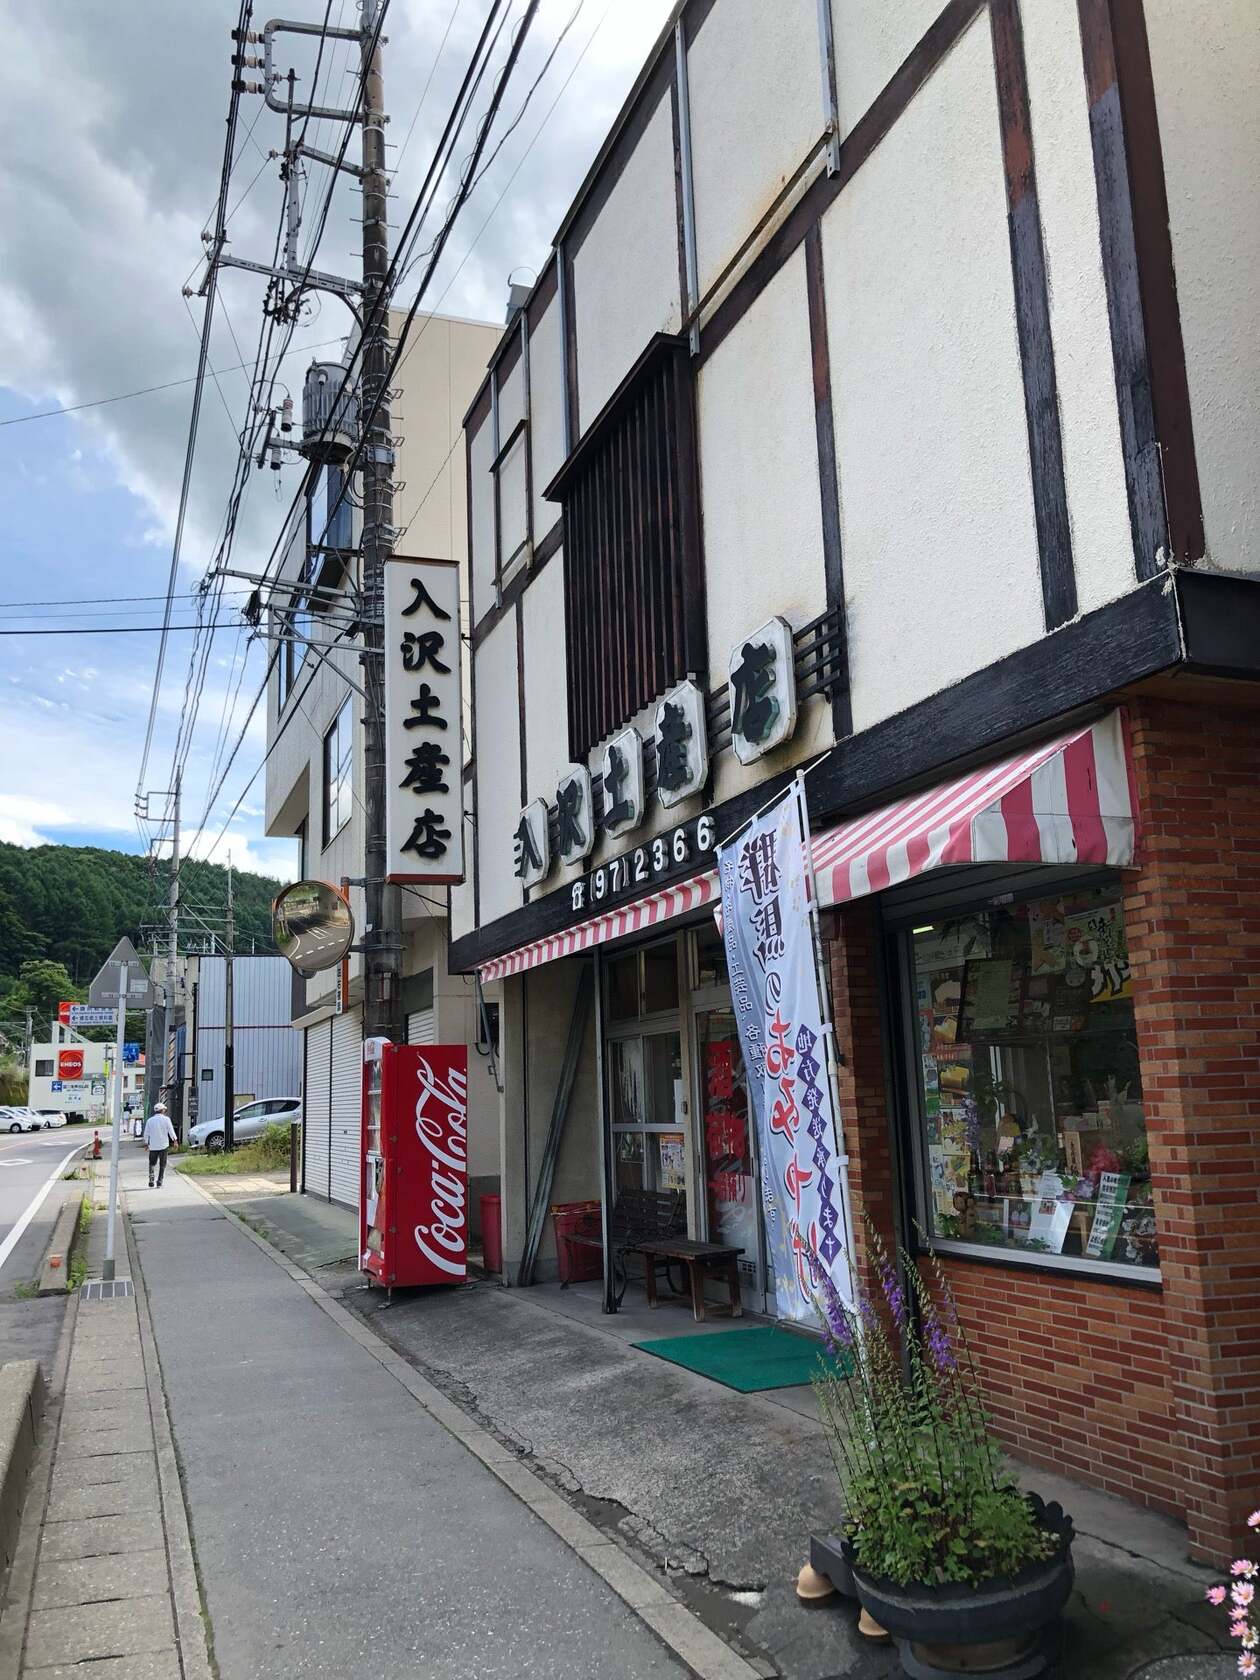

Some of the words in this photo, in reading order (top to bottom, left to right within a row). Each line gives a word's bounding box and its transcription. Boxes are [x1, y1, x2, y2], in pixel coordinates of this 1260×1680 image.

[398, 577, 452, 860] 入沢土産店
[414, 1051, 467, 1276] Coca-Cola
